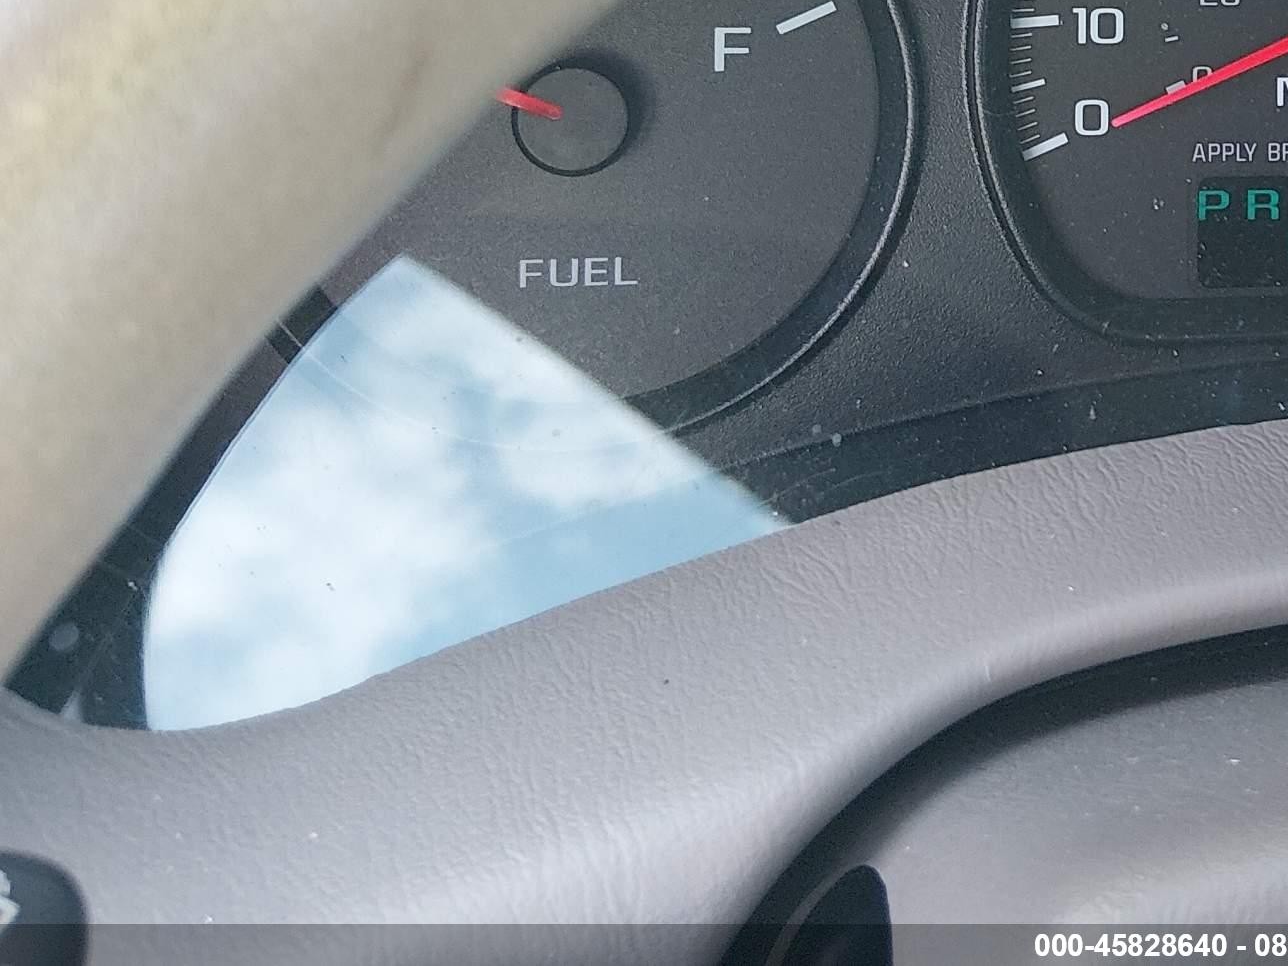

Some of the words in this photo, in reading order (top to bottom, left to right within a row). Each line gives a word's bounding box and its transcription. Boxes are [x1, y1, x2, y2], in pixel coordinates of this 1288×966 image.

[1073, 8, 1123, 43] 10
[714, 27, 751, 71] F
[1075, 100, 1108, 135] 0
[1193, 143, 1256, 162] APPLY
[519, 257, 638, 288] FUEL
